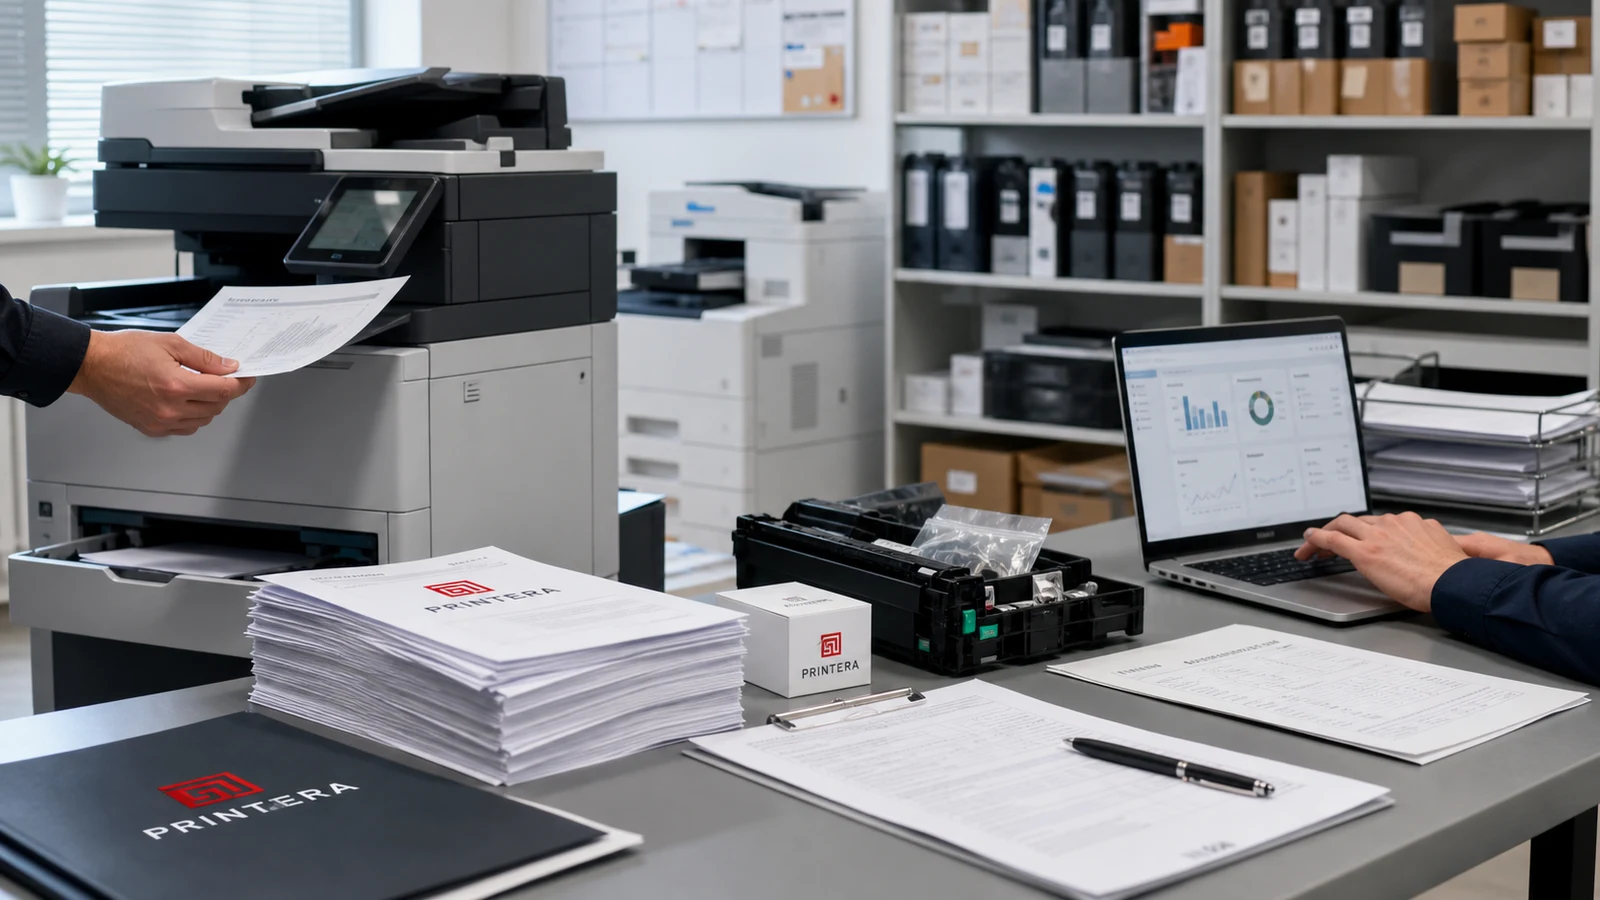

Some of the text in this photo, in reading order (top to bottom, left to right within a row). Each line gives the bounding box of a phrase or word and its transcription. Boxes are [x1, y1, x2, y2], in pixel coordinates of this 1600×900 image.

[424, 587, 561, 613] PRINTERA
[802, 660, 859, 679] PRINTERA
[142, 782, 359, 840] PRINTERA
